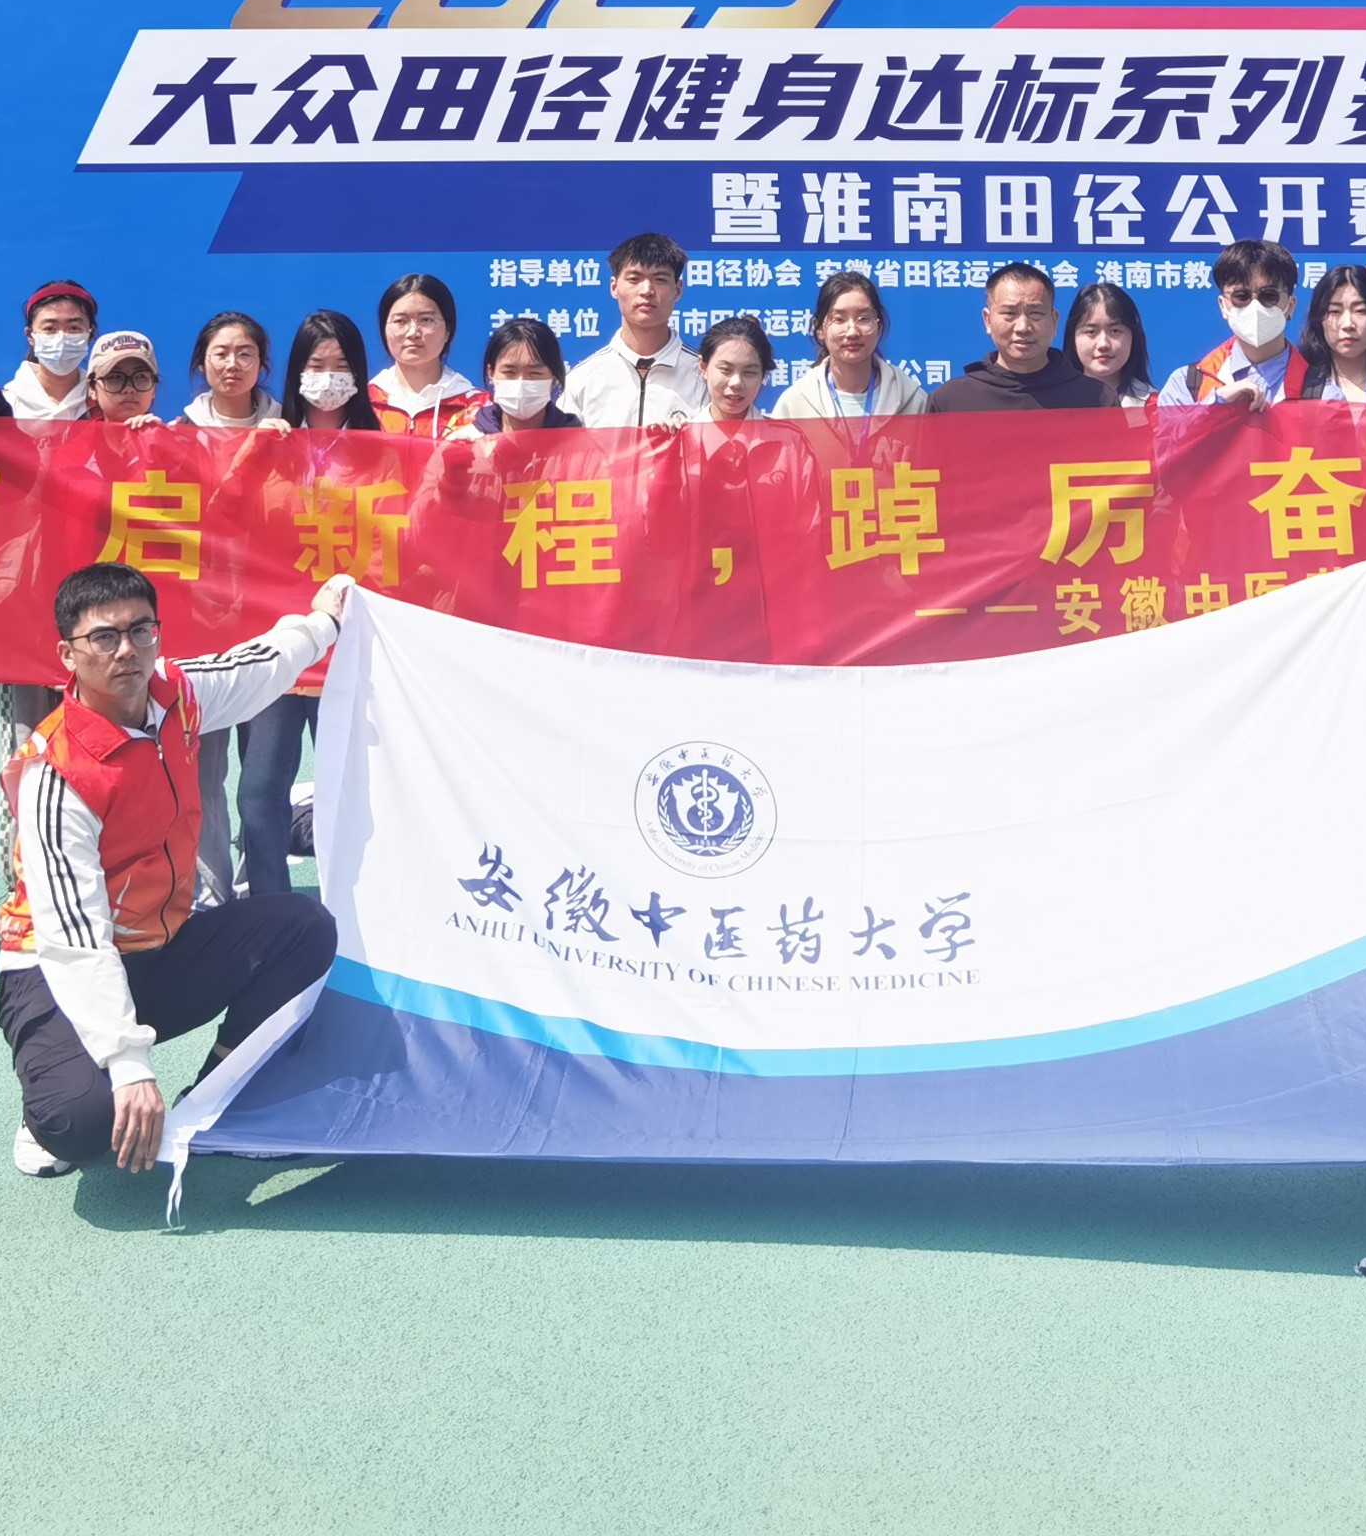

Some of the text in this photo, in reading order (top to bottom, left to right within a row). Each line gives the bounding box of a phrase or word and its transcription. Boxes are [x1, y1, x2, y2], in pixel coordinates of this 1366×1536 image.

[489, 258, 601, 287] 指导单位
[679, 259, 802, 287] 田径协会
[1095, 260, 1327, 289] 淮南市教局
[456, 840, 976, 965] 安徽中医药大学
[445, 911, 982, 993] ANHUI UNIVERSITY OF CHINESE MEDICINE
